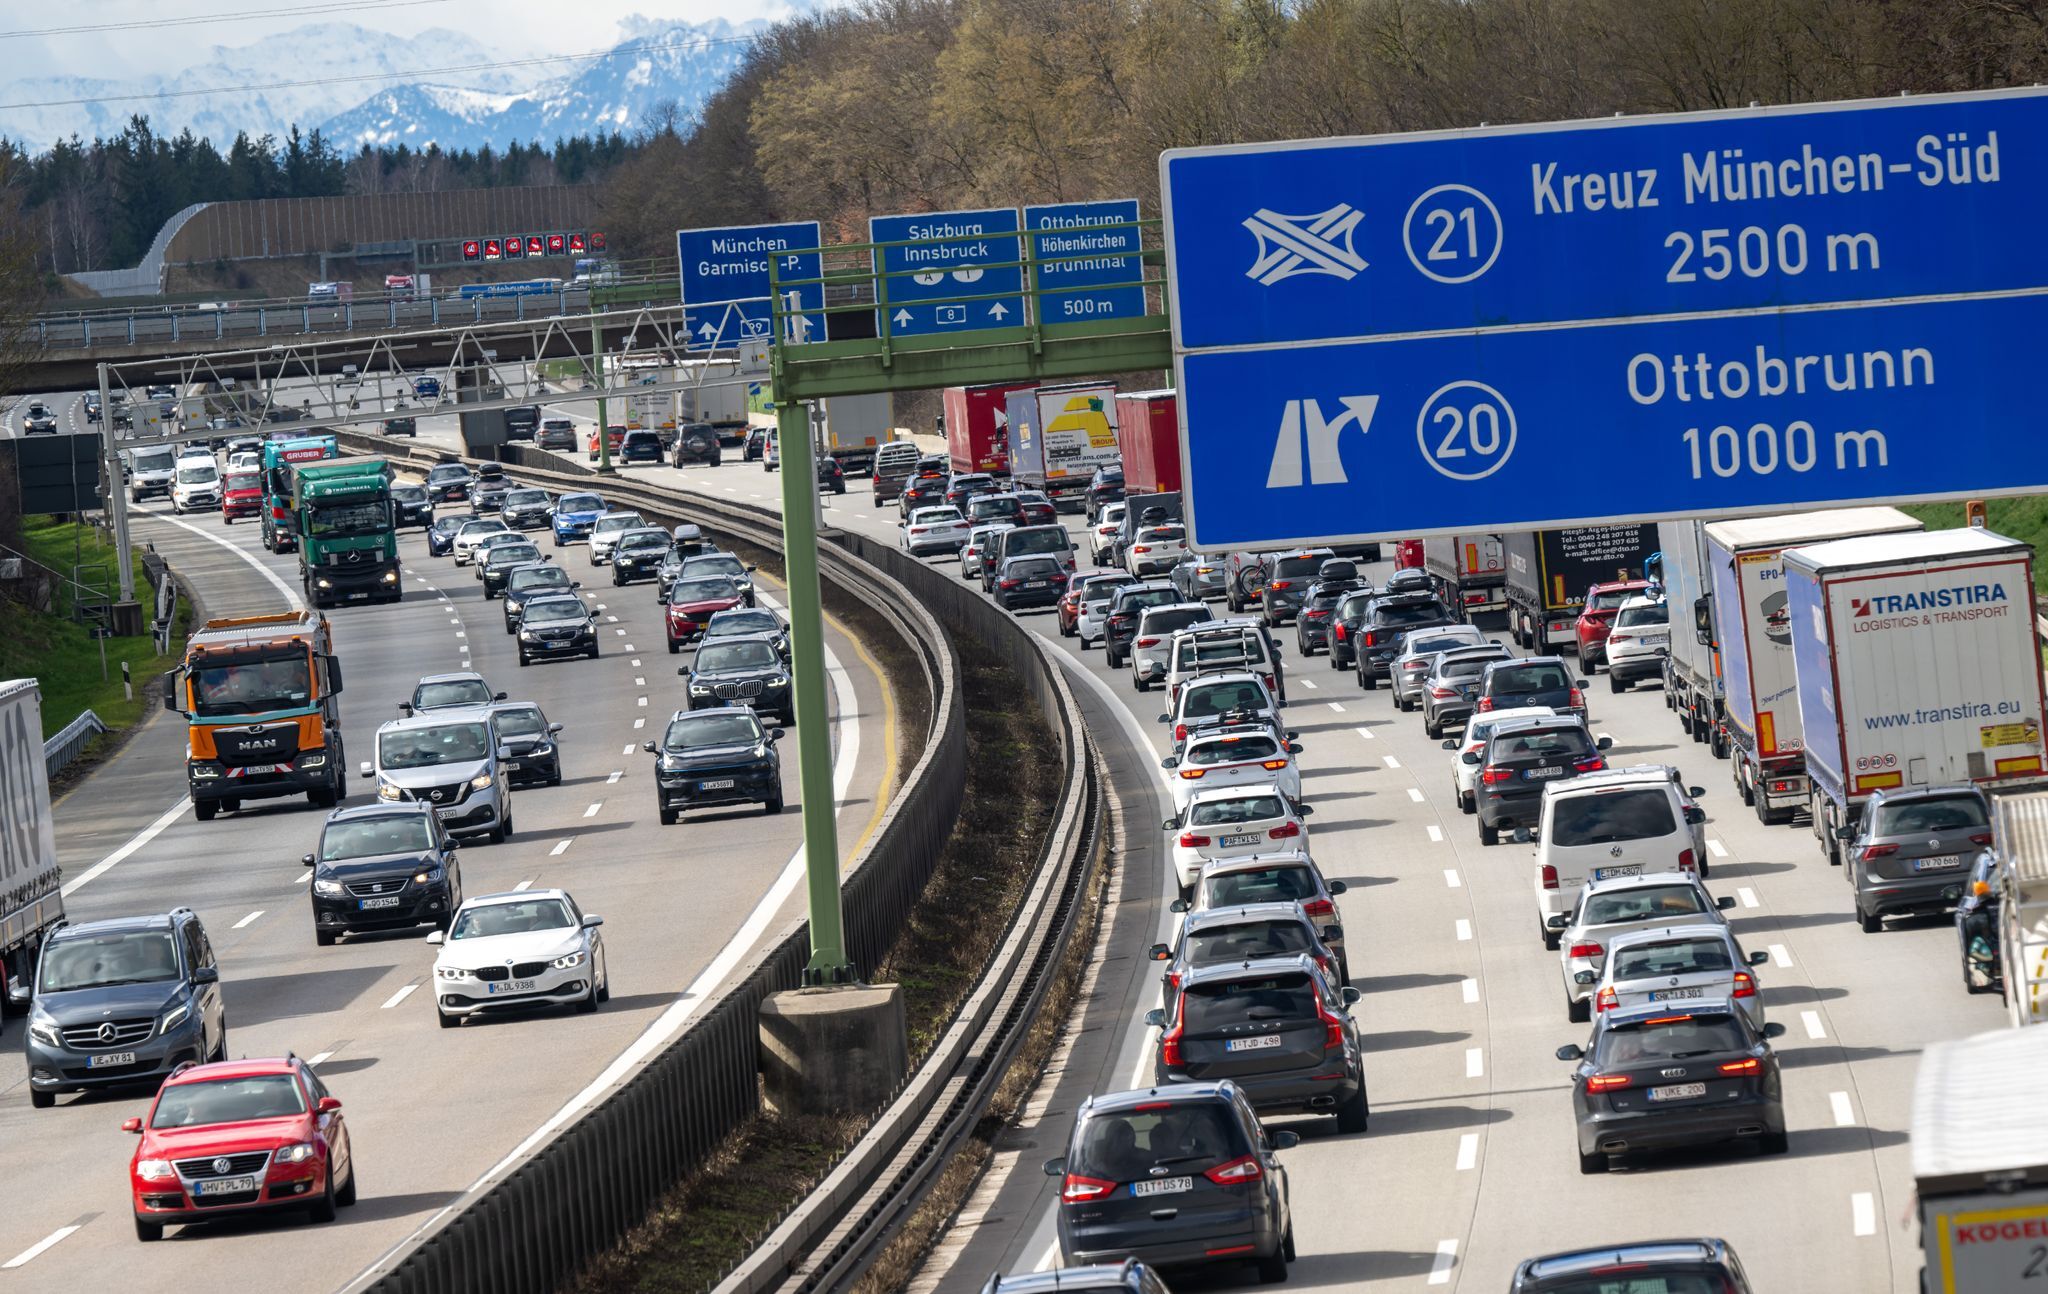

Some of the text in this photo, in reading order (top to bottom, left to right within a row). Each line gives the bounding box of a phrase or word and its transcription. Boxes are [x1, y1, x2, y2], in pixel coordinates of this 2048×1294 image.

[1531, 130, 2000, 215] Kreuz München-Süd
[908, 222, 983, 241] Salzburg
[1040, 215, 1125, 231] Ottobrunn
[1041, 233, 1126, 253] Höhenkirchen
[1425, 207, 1478, 261] 21
[711, 237, 787, 254] München
[904, 242, 988, 262] Innsbruck
[1663, 223, 1880, 283] 2500 m
[698, 255, 802, 276] Garmisc-P.
[946, 310, 955, 320] 8
[1063, 299, 1113, 315] 500 m
[1626, 345, 1935, 406] Ottobrunn
[1433, 403, 1501, 460] 20
[1091, 438, 1114, 447] GROUP
[1682, 420, 1889, 480] 1000 m
[286, 450, 320, 461] GRUBER
[1760, 568, 1787, 580] EPO-
[1871, 583, 2008, 615] TRANSTIRA
[1853, 605, 2009, 633] LOGISTICS & TRANSPORT
[1864, 700, 2021, 730] www.transtira.eu
[239, 738, 276, 751] MAN
[1221, 1022, 1281, 1033] VOLVO
[240, 1178, 252, 1189] 79
[1136, 1178, 1191, 1194] BIT DS 78
[2022, 1244, 2048, 1280] 2
